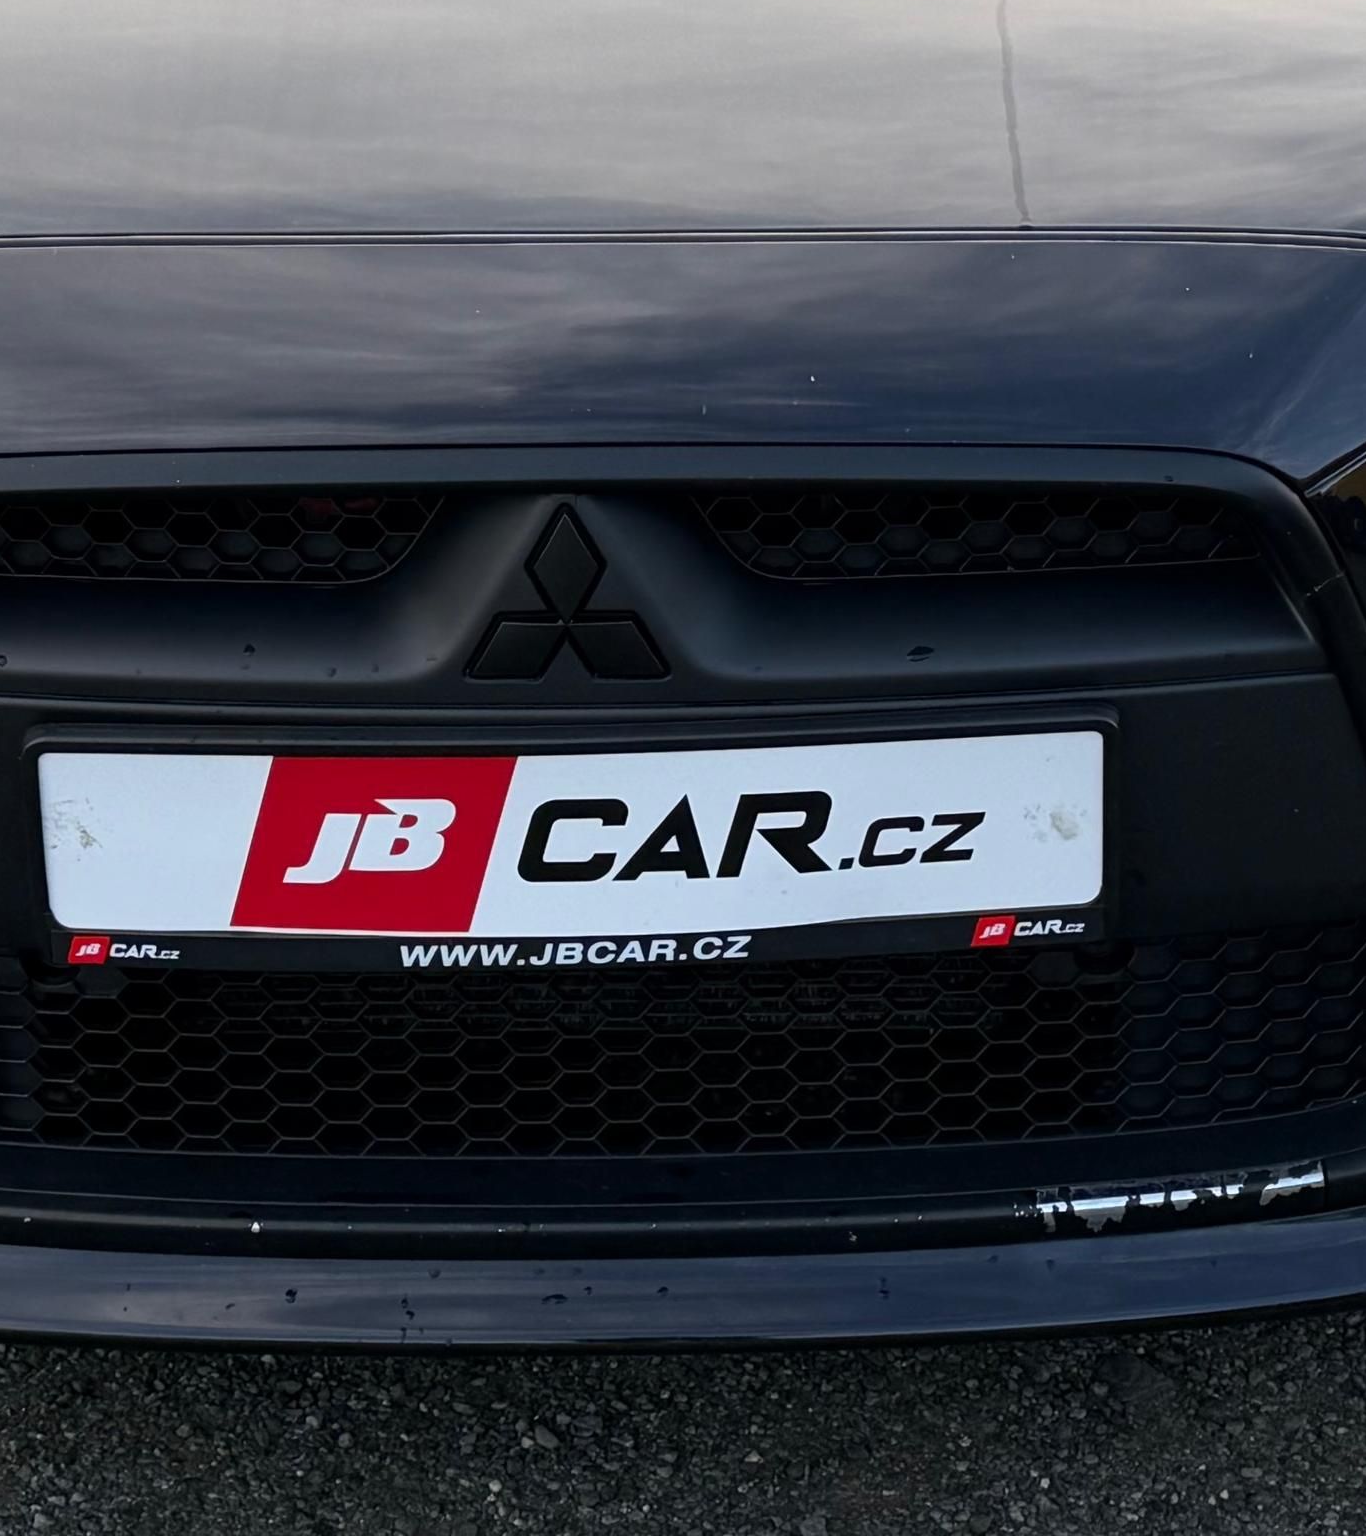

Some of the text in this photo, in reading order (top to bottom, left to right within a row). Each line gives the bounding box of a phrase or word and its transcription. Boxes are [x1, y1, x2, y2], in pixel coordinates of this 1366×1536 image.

[282, 798, 457, 884] JB
[979, 923, 1006, 939] JB
[75, 943, 101, 956] JB
[399, 935, 753, 967] WWW.JBCAR.CZ
